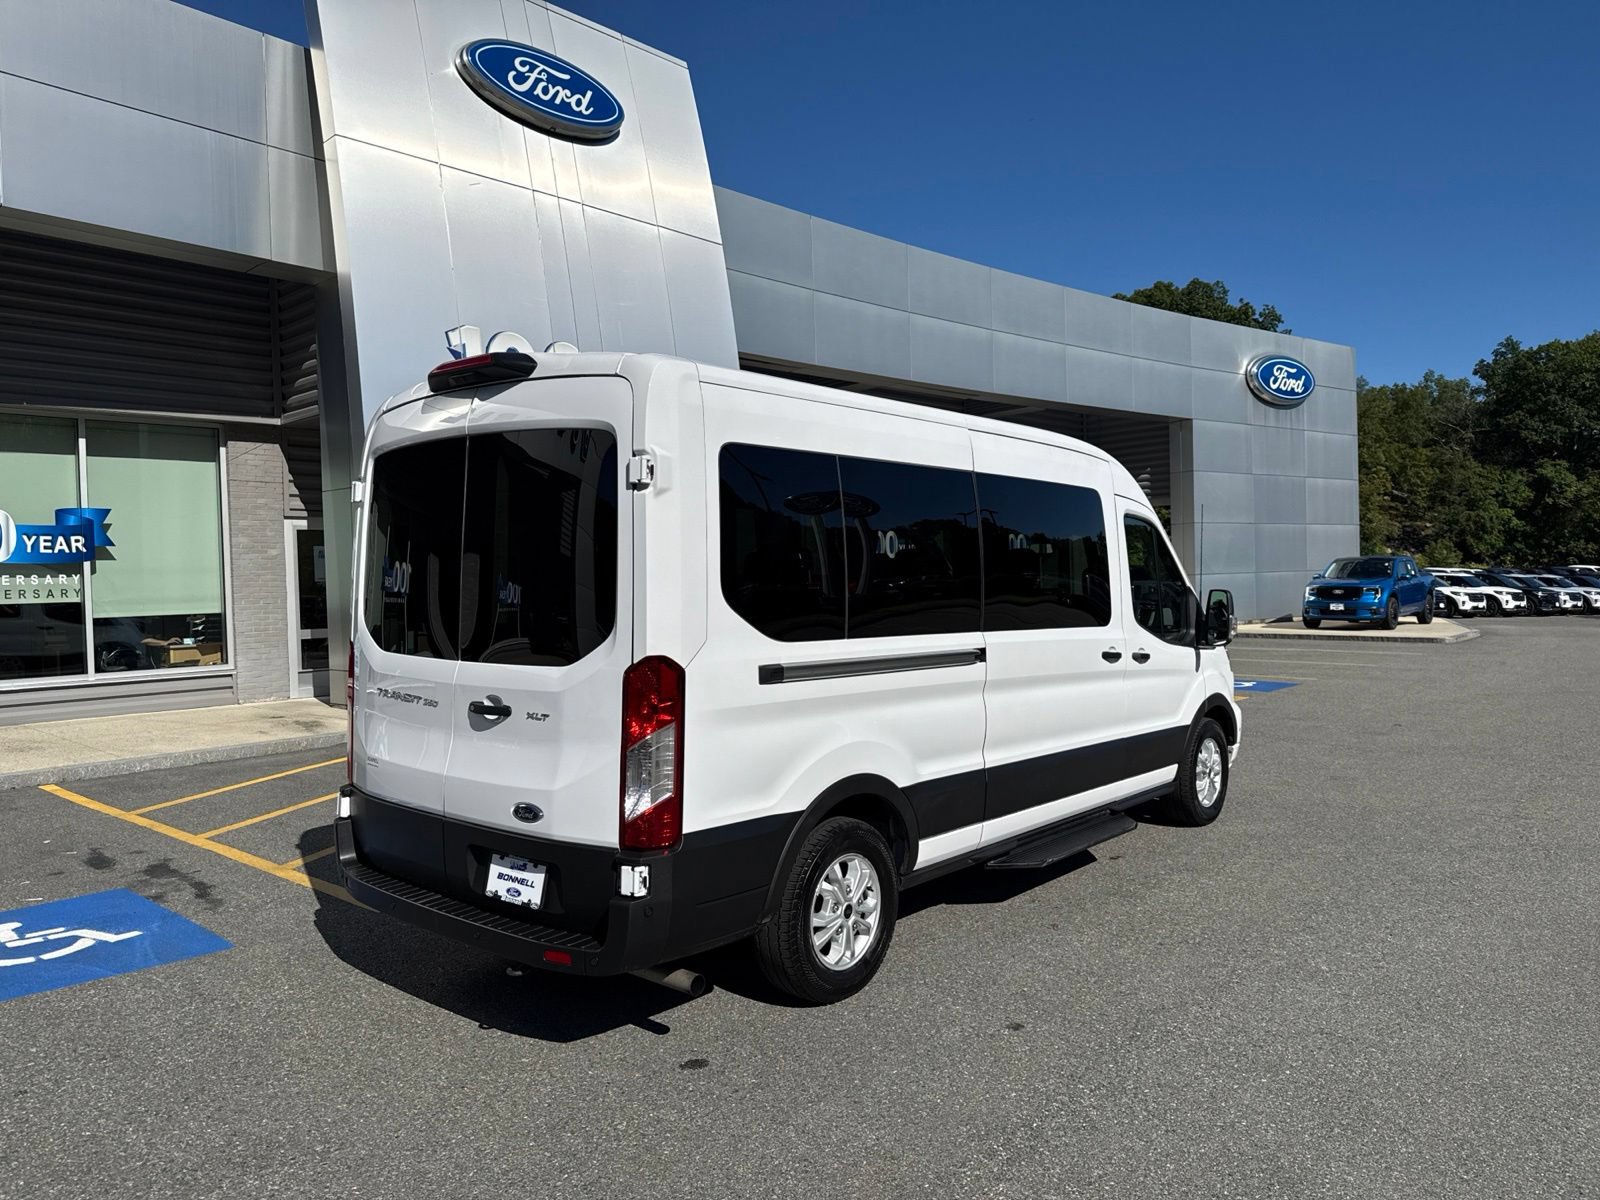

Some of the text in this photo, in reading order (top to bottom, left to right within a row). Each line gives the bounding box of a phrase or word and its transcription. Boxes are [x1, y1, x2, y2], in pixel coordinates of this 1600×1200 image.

[507, 57, 594, 115] Ford
[1269, 364, 1306, 393] Ford
[22, 534, 87, 554] YEAR
[377, 687, 423, 704] TRANSIT
[526, 711, 550, 722] XLT
[497, 872, 535, 888] BONNELL
